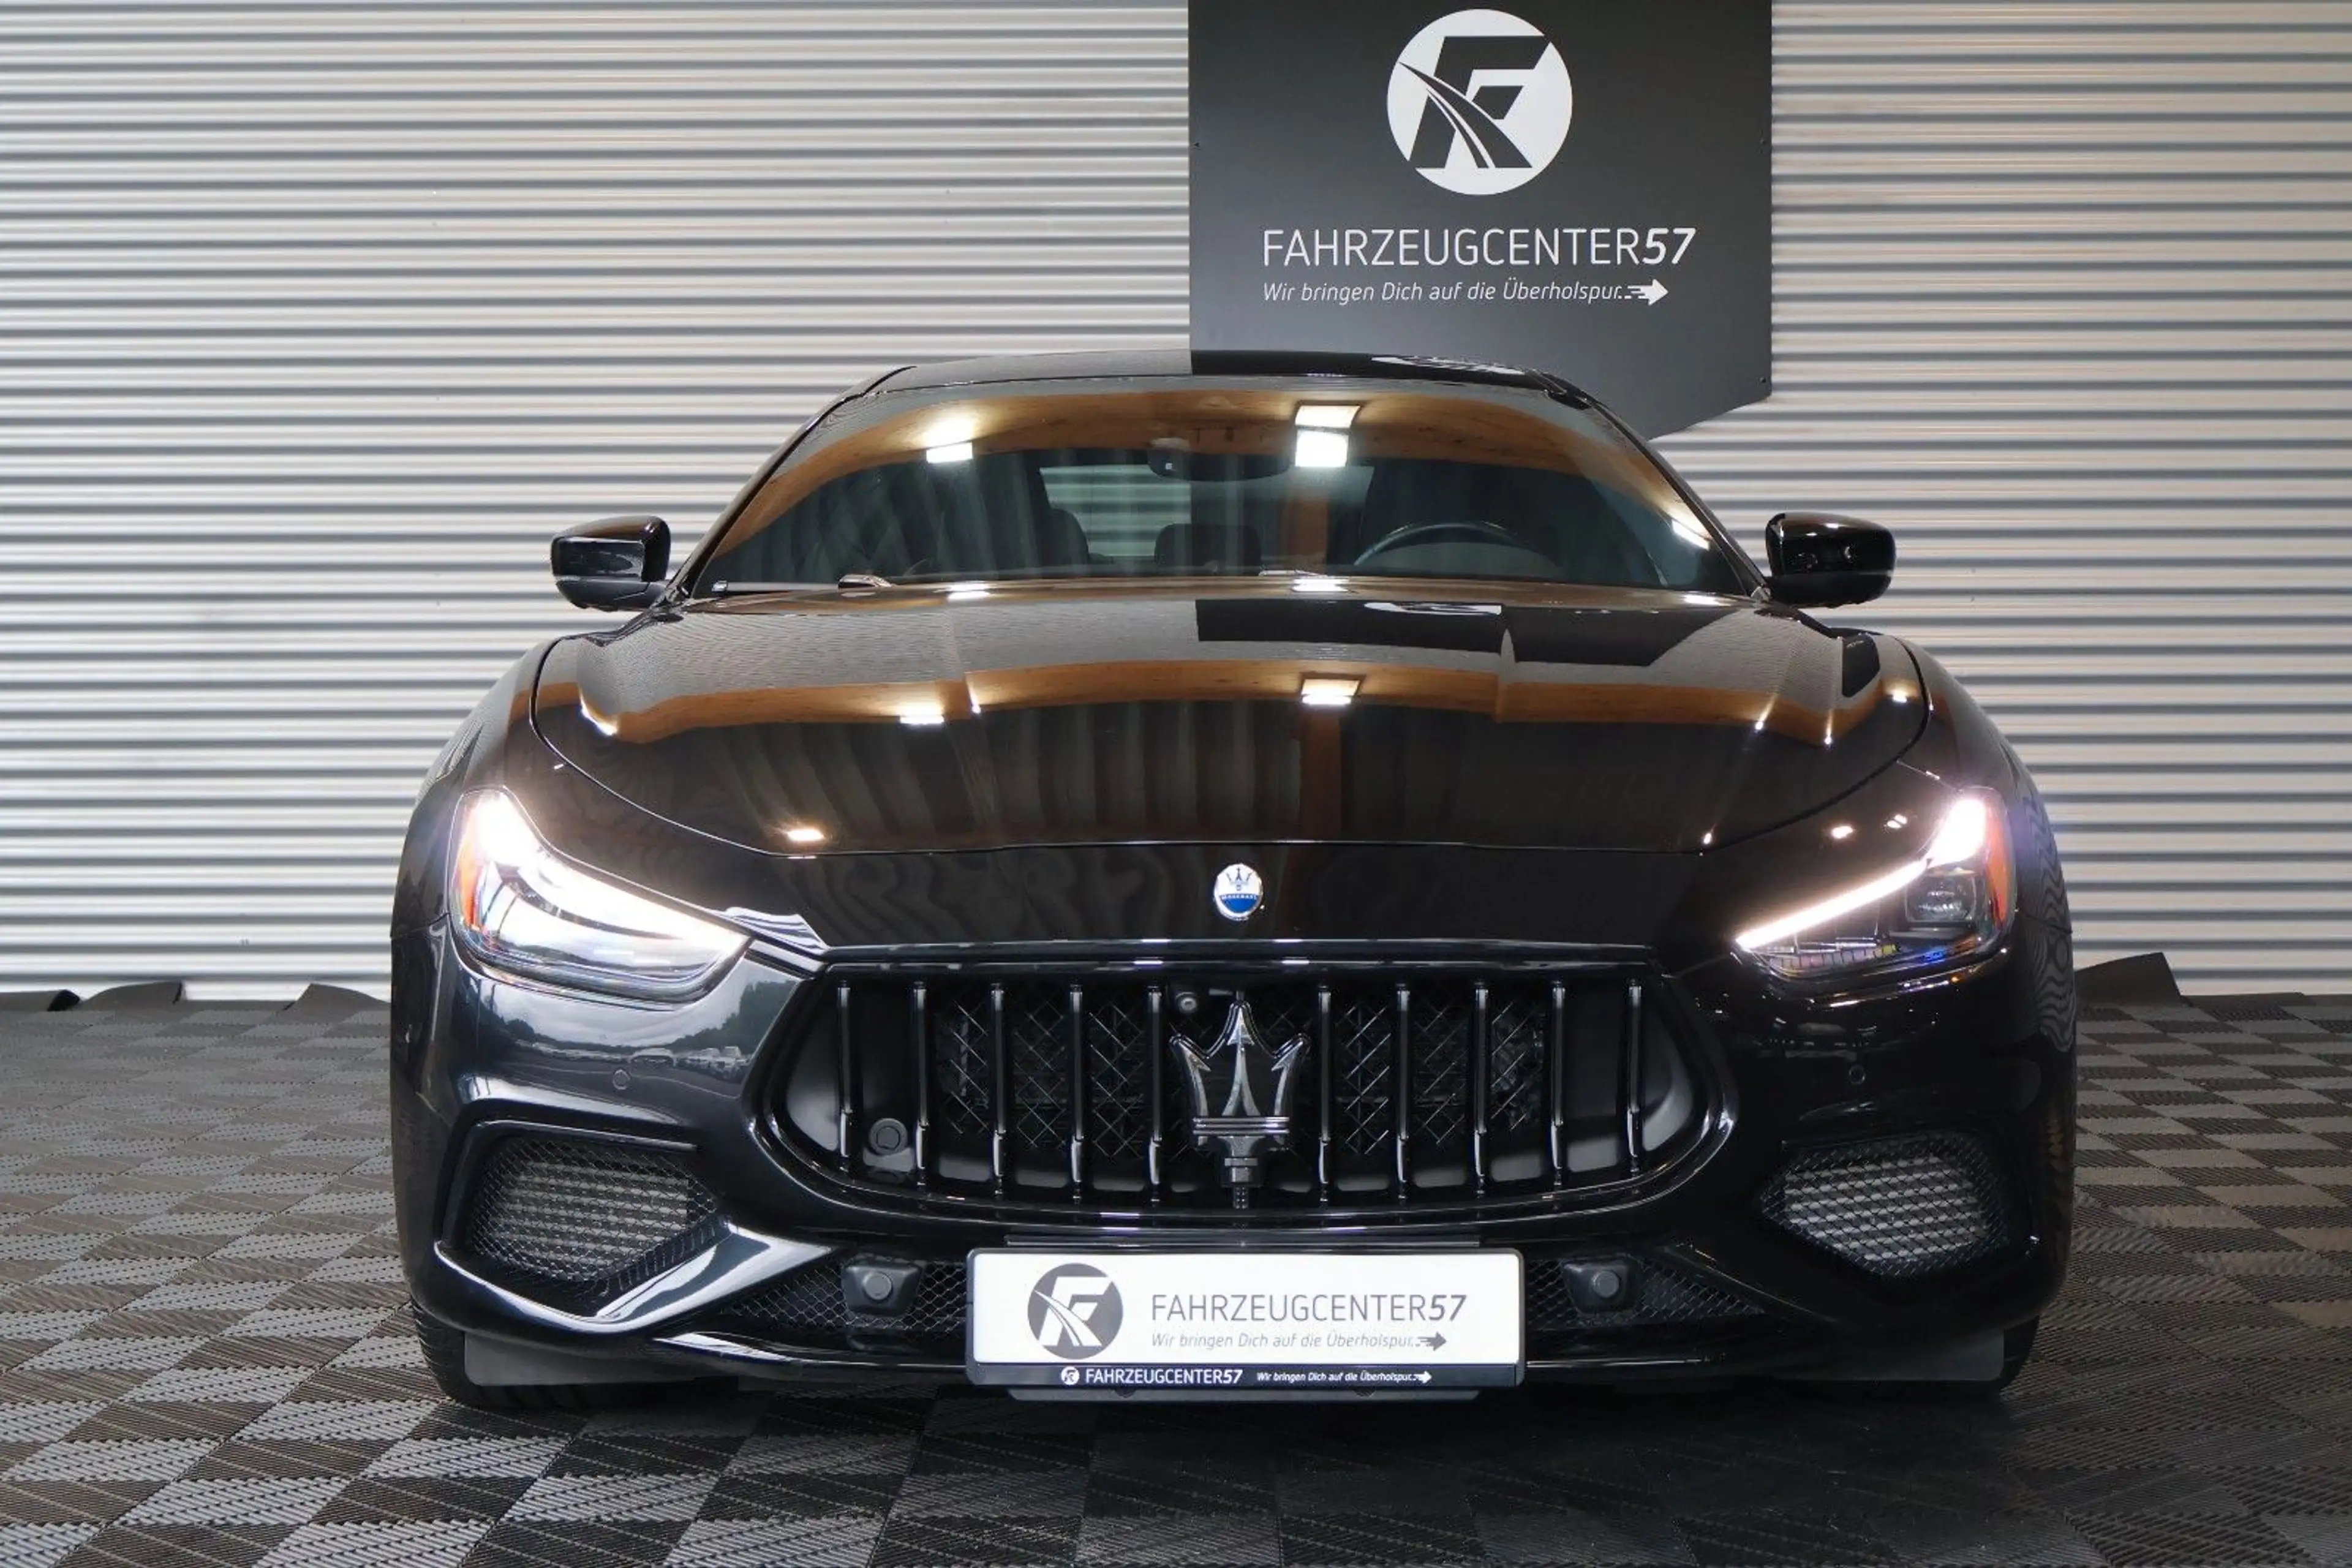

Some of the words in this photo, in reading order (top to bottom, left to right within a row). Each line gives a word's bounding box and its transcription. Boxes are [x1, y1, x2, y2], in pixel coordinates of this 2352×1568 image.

[1264, 228, 1697, 266] FAHRZEUGCENTER57
[1264, 282, 1295, 301] Wir
[1300, 282, 1375, 306] bringen
[1381, 282, 1422, 301] Dich
[1428, 282, 1463, 301] auf
[1467, 281, 1496, 300] die
[1152, 1294, 1468, 1322] FAHRZEUGCENTER57
[1152, 1333, 1175, 1348] Wir
[1180, 1333, 1234, 1351] bringen
[1238, 1333, 1268, 1348] Dich
[1272, 1333, 1297, 1348] auf
[1301, 1333, 1322, 1348] die
[1085, 1368, 1243, 1384] FAHRZEUGCENTER57
[1257, 1372, 1272, 1381] Wir
[1273, 1372, 1306, 1384] bringen
[1308, 1372, 1327, 1381] Dich
[1328, 1372, 1344, 1381] auf
[1345, 1371, 1358, 1381] die
